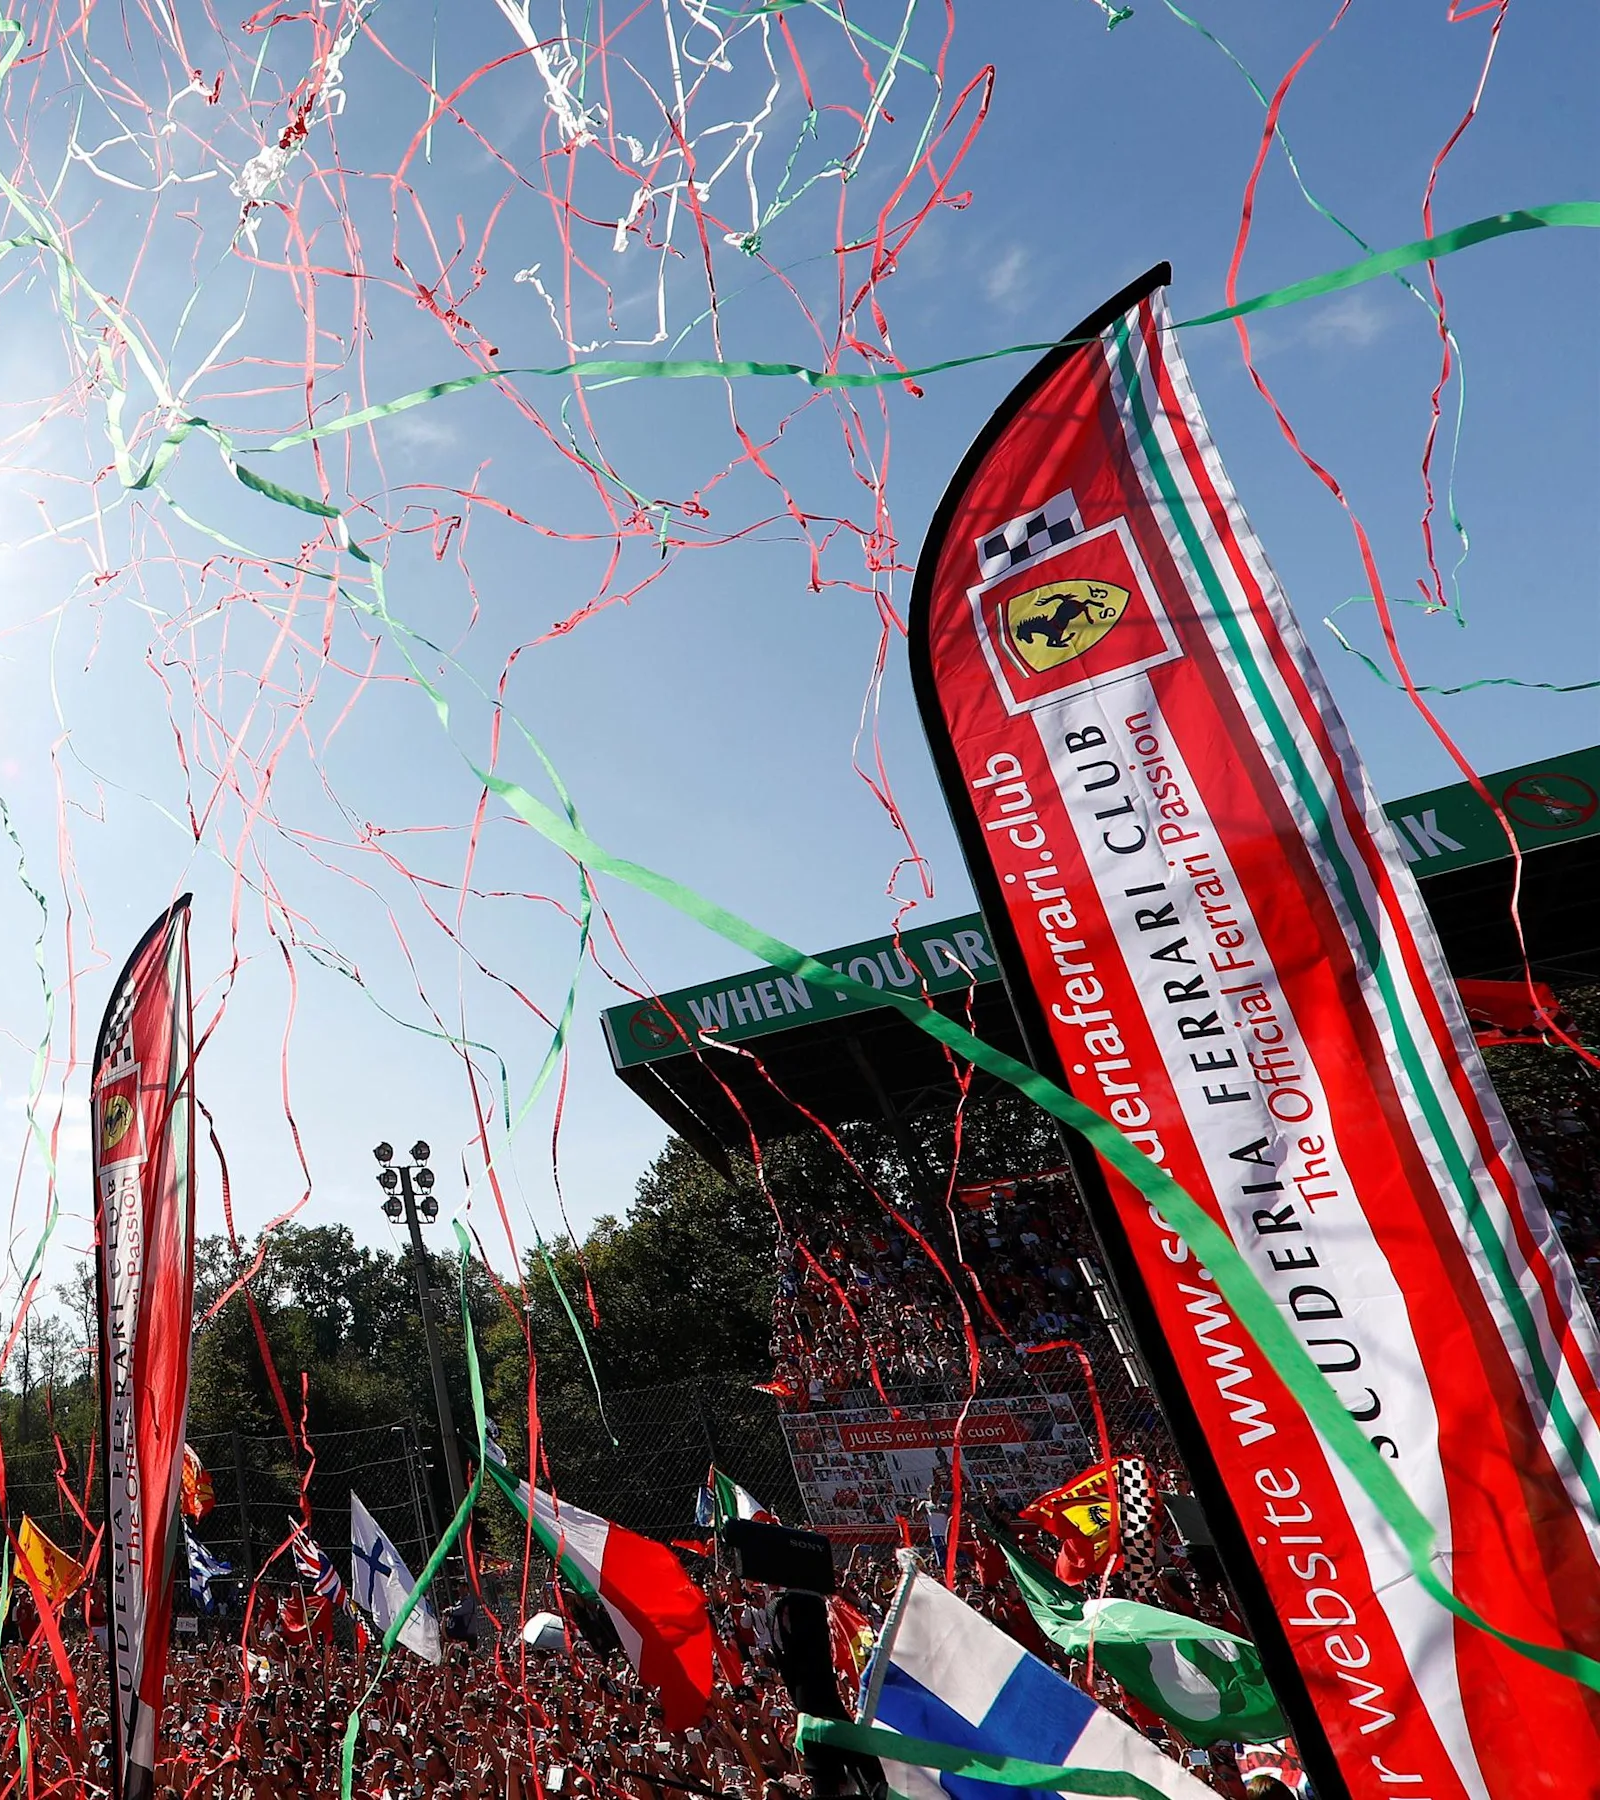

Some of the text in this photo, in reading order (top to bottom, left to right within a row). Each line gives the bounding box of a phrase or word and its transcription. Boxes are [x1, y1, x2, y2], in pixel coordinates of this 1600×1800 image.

[1098, 606, 1117, 620] S
[1064, 724, 1147, 855] CLUB
[687, 975, 813, 1032] WHEN
[1124, 711, 1339, 1215] The Official Ferrari Passion
[1124, 882, 1252, 1105] FERRARI
[972, 752, 1277, 1447] www.scderiaferrari.club
[123, 1177, 141, 1277] Passion
[108, 1179, 133, 1731] UDERIA FERRARI CLUB
[850, 1423, 1006, 1448] JULES nei nosti cuori
[126, 1514, 141, 1574] The
[789, 1538, 825, 1553] SONY
[1255, 1467, 1396, 1735] website
